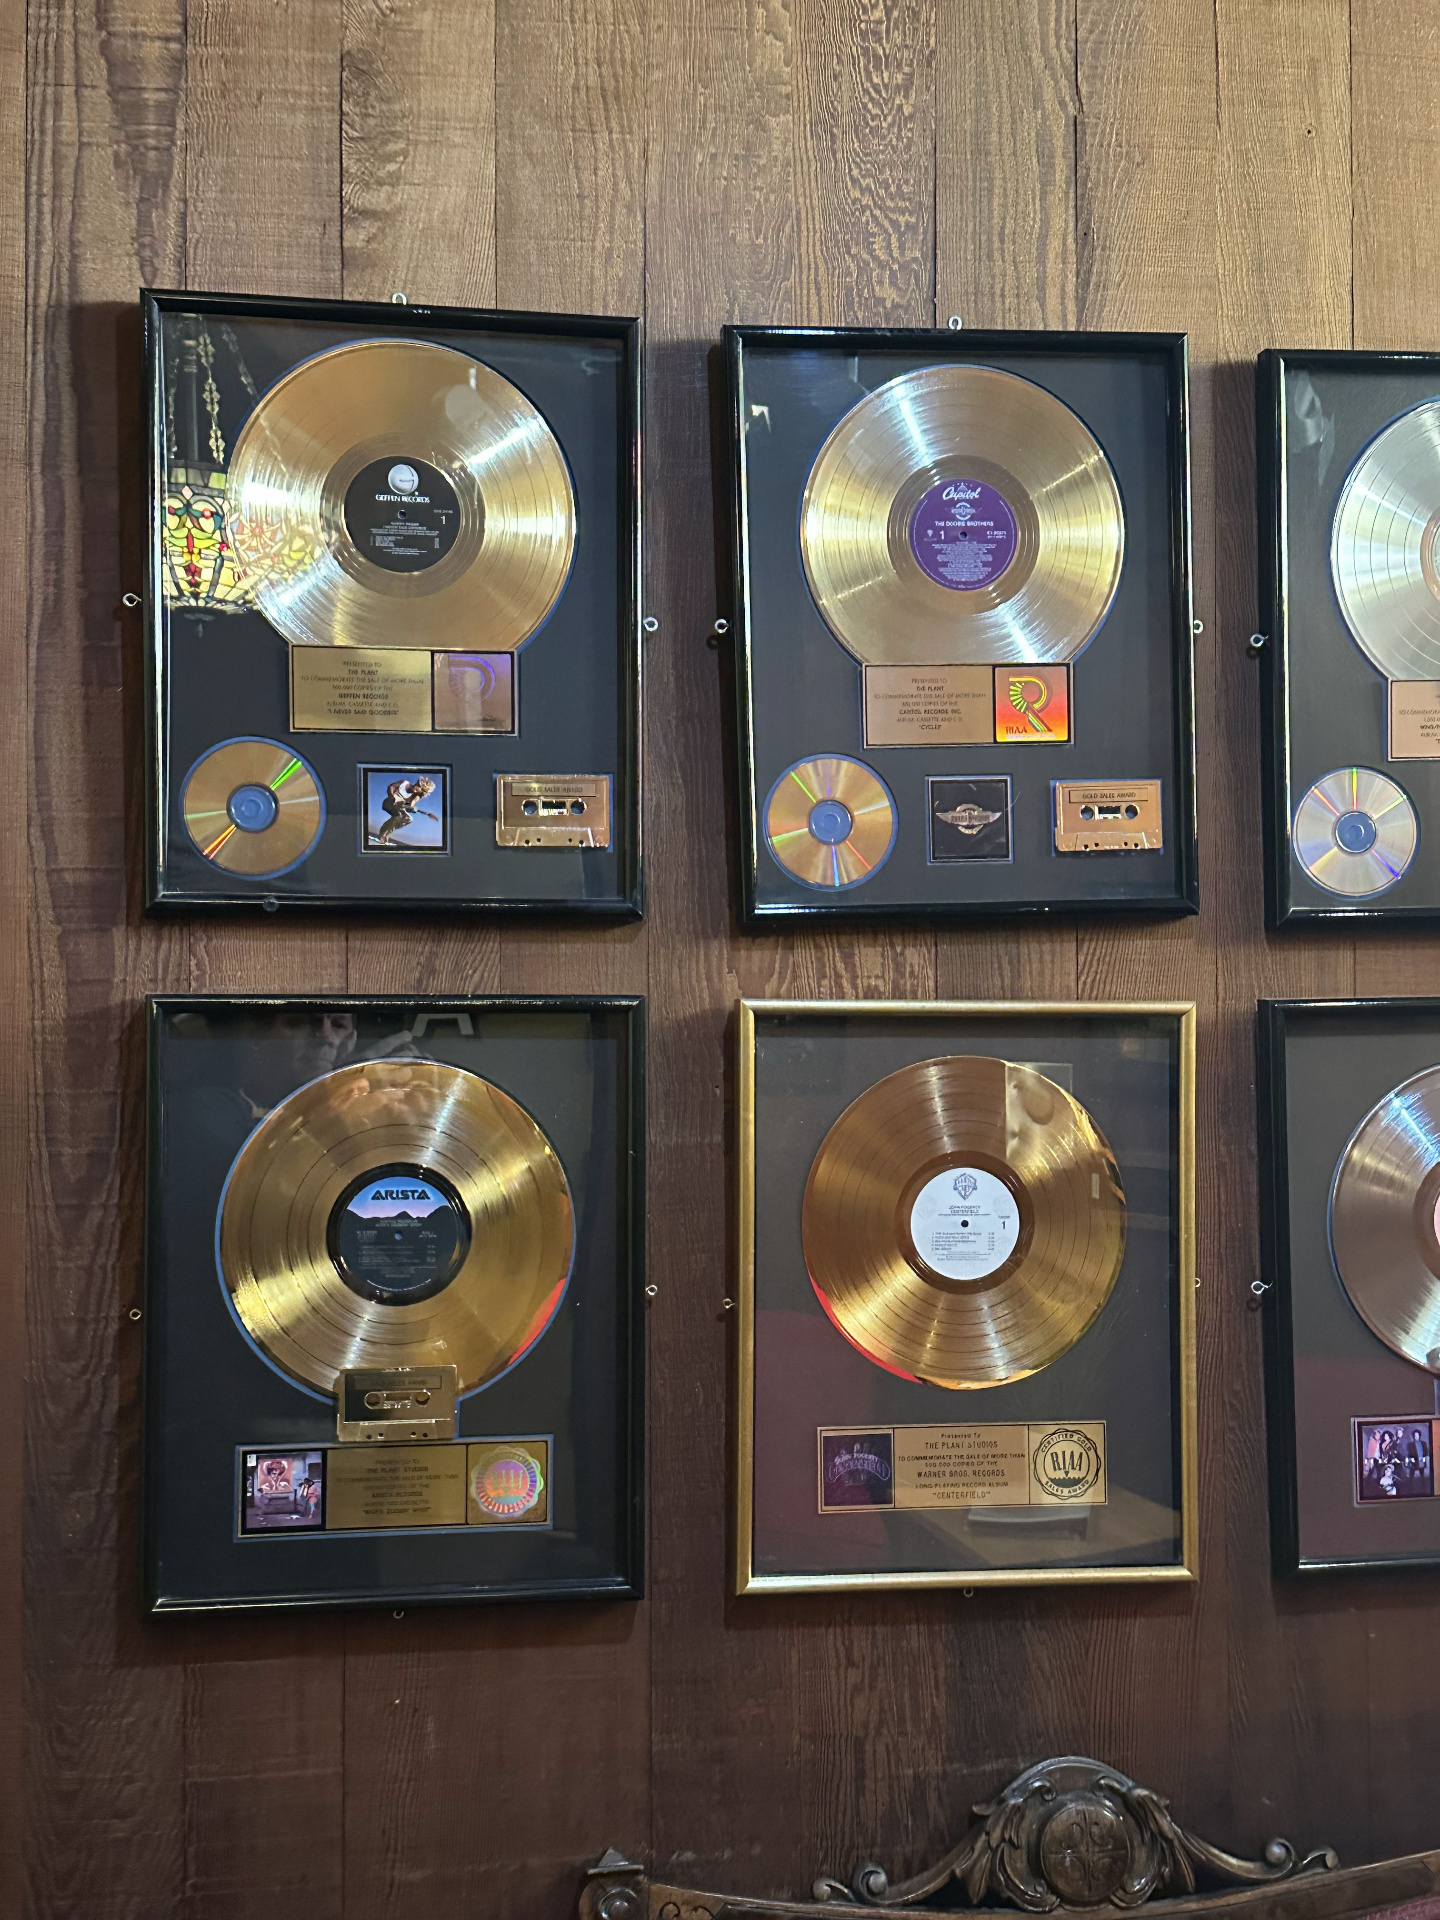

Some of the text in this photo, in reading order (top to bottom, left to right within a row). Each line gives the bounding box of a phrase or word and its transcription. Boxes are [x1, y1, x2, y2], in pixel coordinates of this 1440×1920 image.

[942, 486, 982, 501] Capitol
[440, 515, 446, 525] 1
[940, 530, 945, 540] 1
[1082, 792, 1098, 800] GOLD
[370, 1189, 431, 1201] ARISTA
[1001, 1220, 1006, 1230] 1
[925, 1440, 998, 1450] THE PLANT STUDIOS
[1041, 1433, 1092, 1453] CERTIFIED GOLD
[906, 1454, 952, 1462] COMMEMORATE
[1050, 1450, 1083, 1472] RIAA
[917, 1469, 1005, 1478] WARNER BROS. RECORDS
[1045, 1480, 1090, 1494] SALES AWARD
[932, 1491, 991, 1500] "CENTERFIELD"
